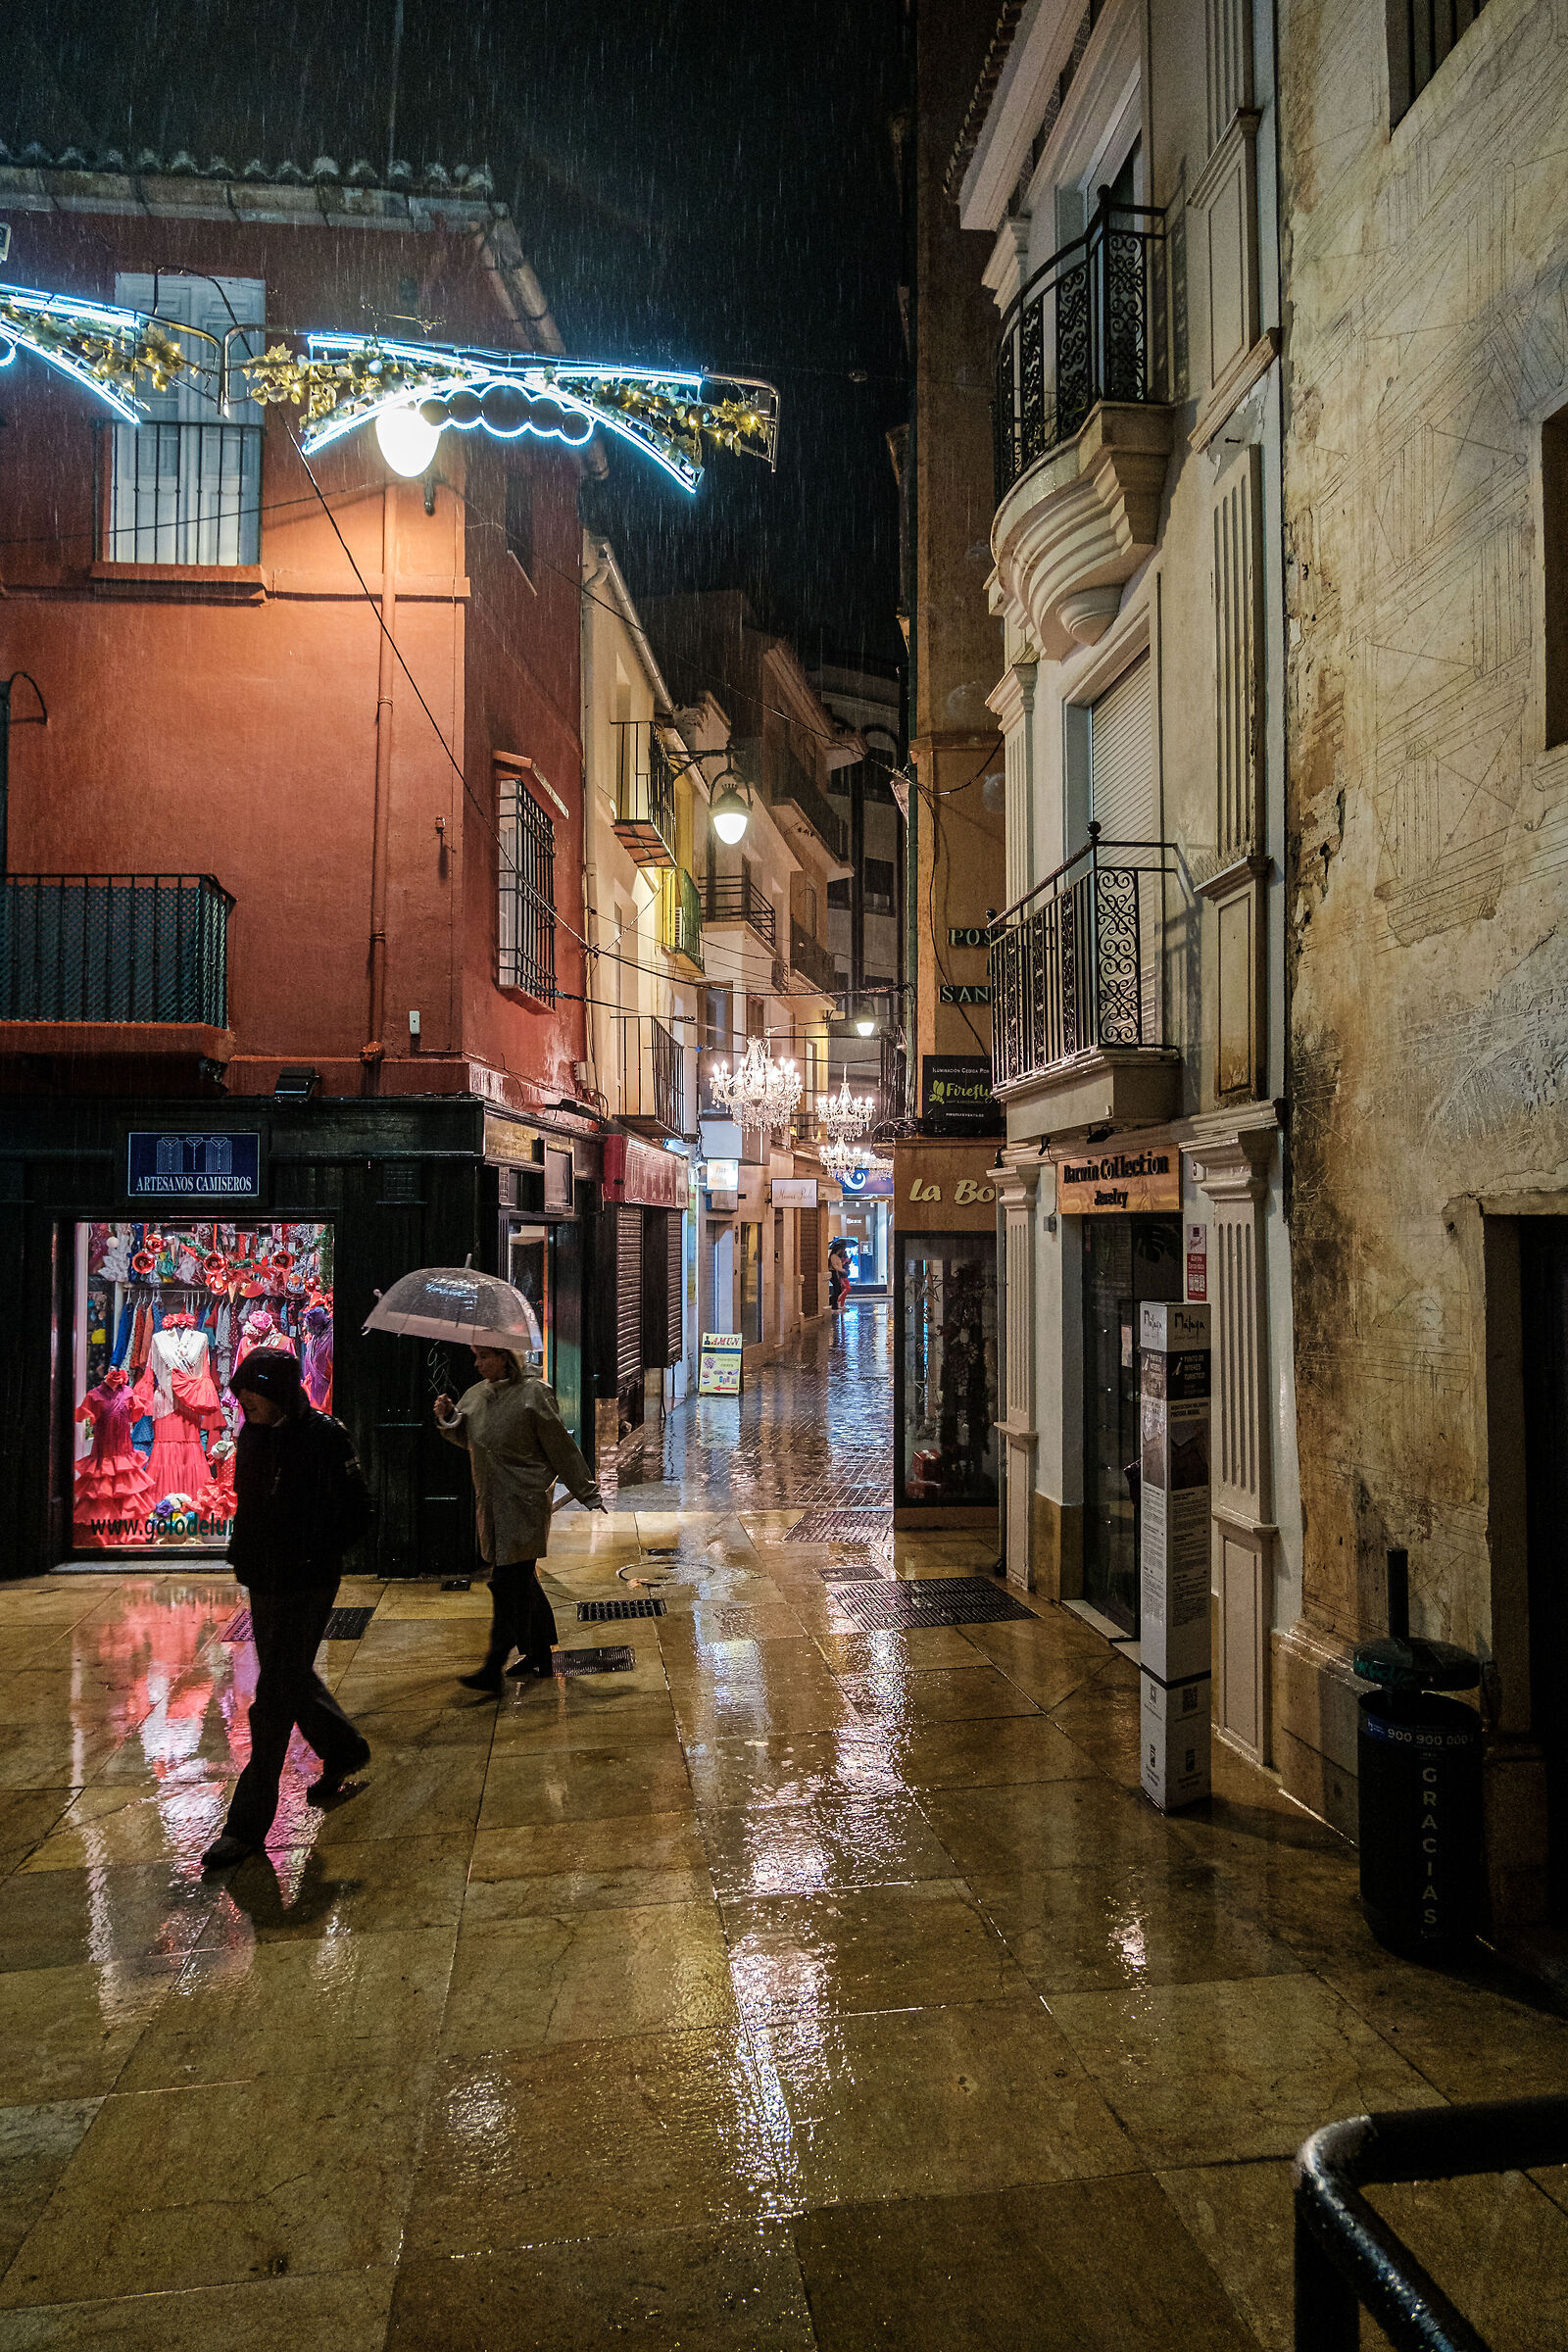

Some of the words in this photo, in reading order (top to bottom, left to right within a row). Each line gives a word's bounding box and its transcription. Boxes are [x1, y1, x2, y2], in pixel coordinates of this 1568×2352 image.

[942, 985, 990, 1003] SAN
[946, 1082, 993, 1103] Firefly
[1101, 1152, 1169, 1180] Collection
[136, 1176, 194, 1192] ARTESANOS
[196, 1176, 252, 1192] CAMISEROS
[909, 1178, 942, 1201] La
[954, 1179, 996, 1205] Bo
[1094, 1188, 1128, 1208] Jewelry
[710, 1337, 741, 1346] AMUN
[1388, 1728, 1412, 1742] 900
[1416, 1734, 1443, 1745] 900
[1421, 1767, 1439, 1925] GRACIAS
